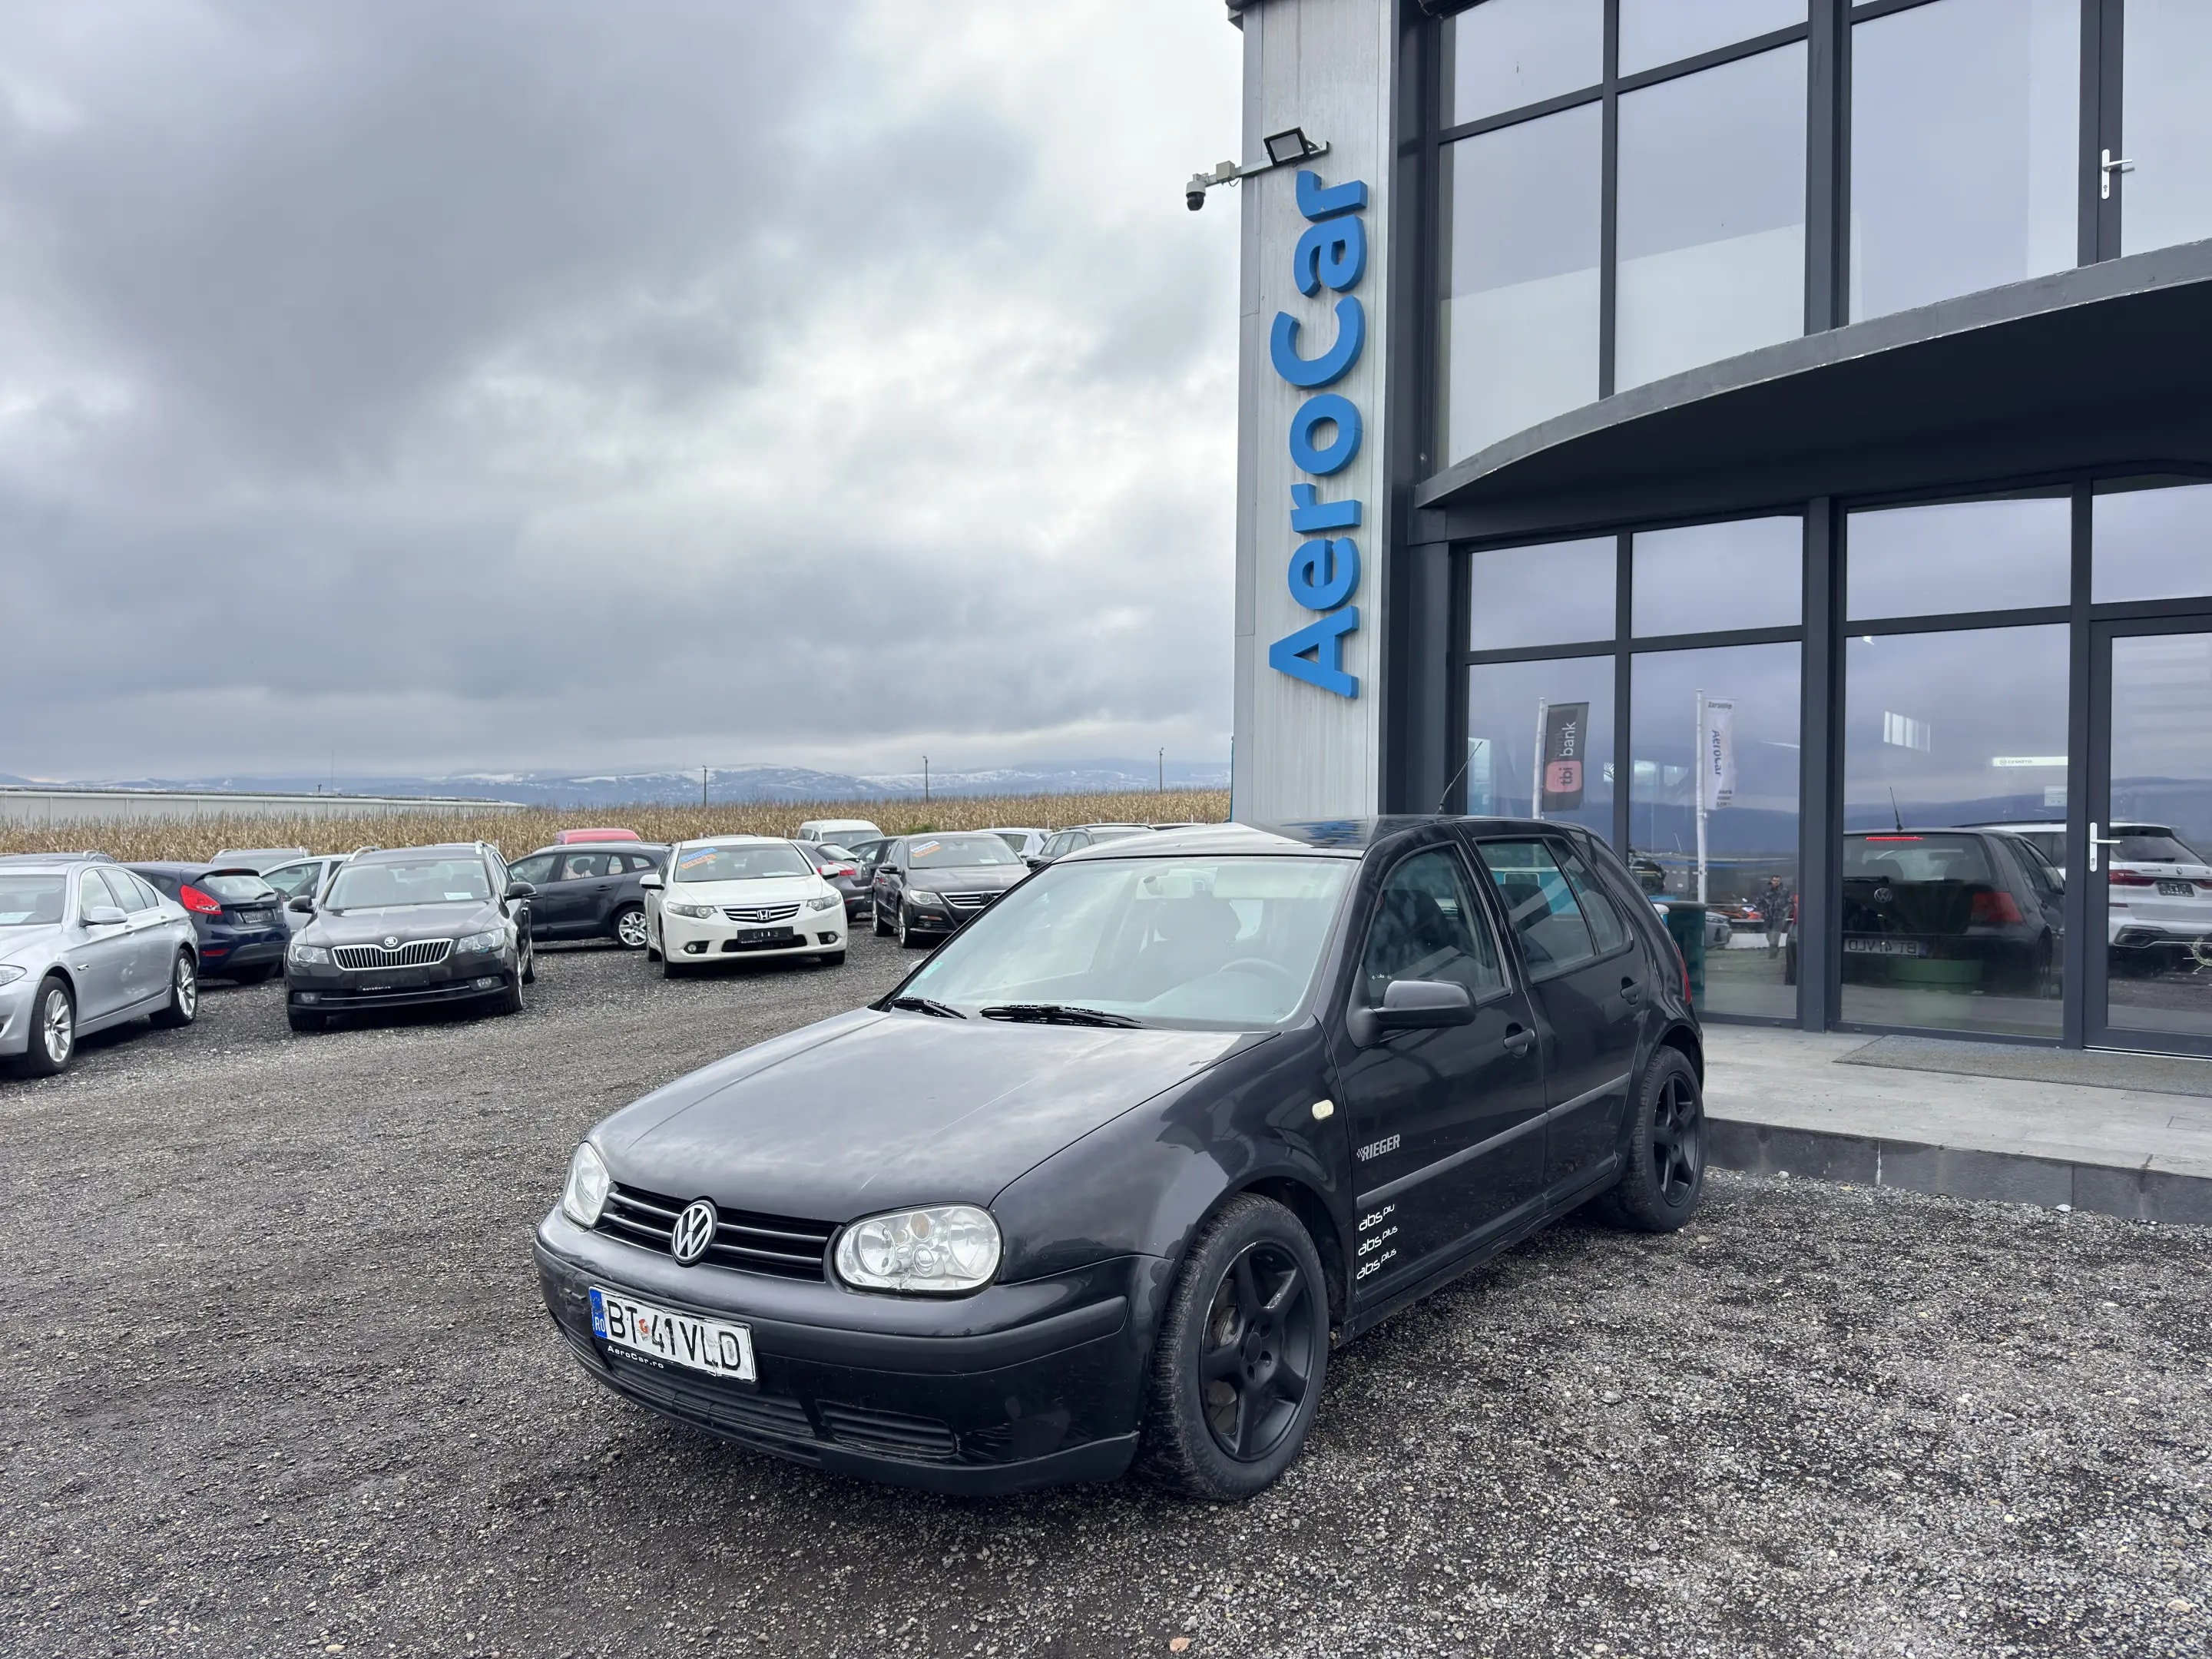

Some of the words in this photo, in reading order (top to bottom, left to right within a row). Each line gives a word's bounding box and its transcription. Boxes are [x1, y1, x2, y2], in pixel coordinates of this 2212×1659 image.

[1270, 171, 1368, 700] AeroCar
[1560, 721, 1576, 757] bank
[1559, 767, 1573, 786] tbi
[1362, 1134, 1400, 1161] RIEGER
[1359, 1211, 1383, 1231] abs
[1358, 1236, 1382, 1256] abs
[1382, 1226, 1398, 1240] plus
[1356, 1259, 1380, 1280] abs
[1381, 1248, 1397, 1263] plus
[594, 1316, 606, 1333] RO
[608, 1345, 664, 1369] AeroCar.ro
